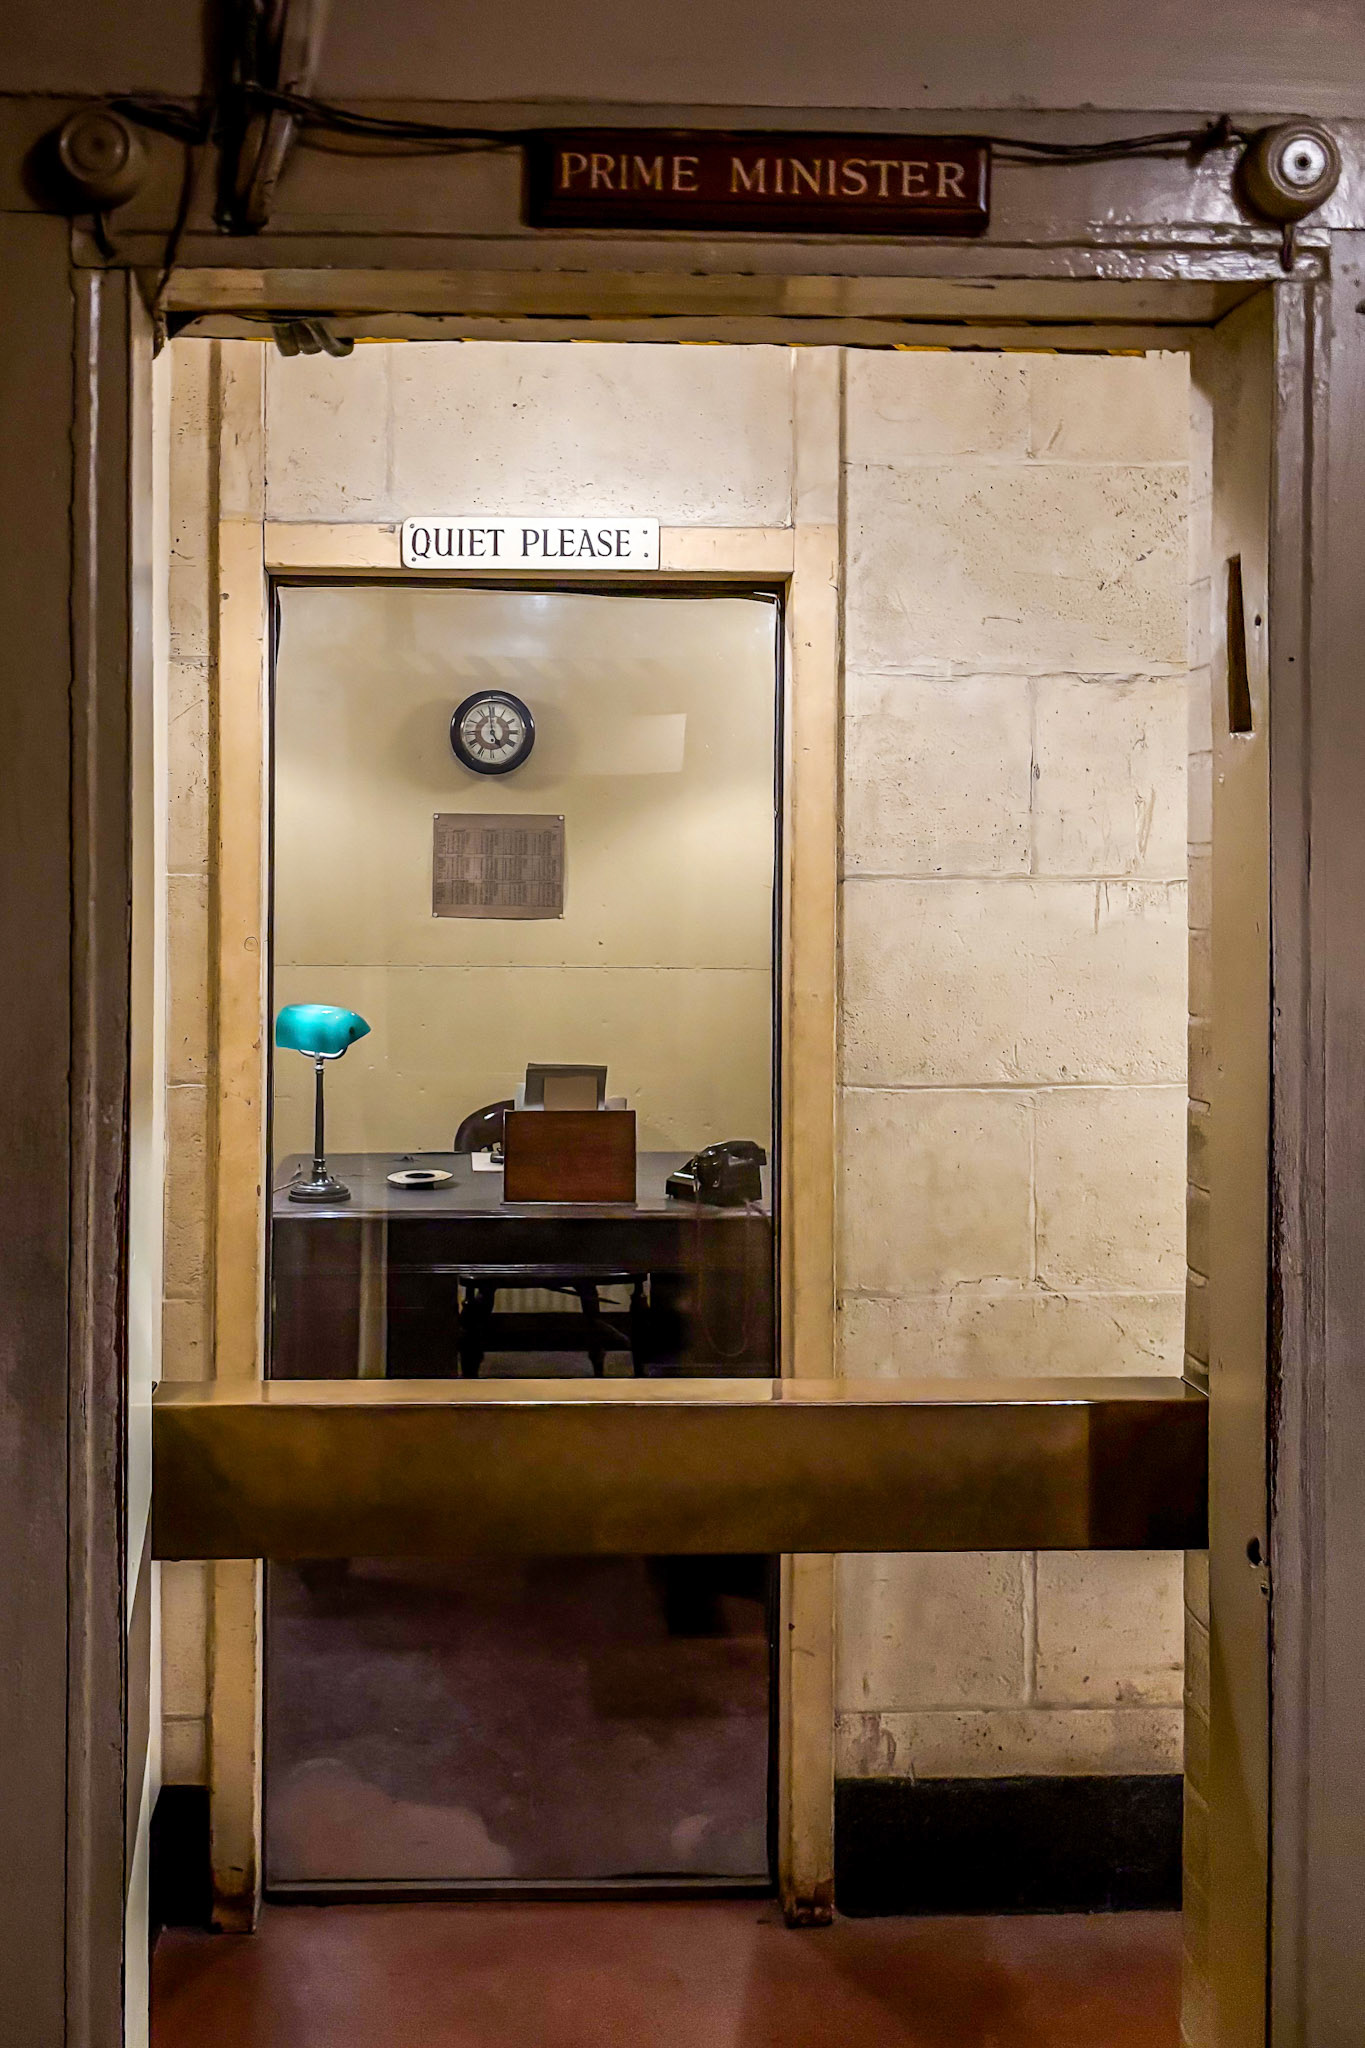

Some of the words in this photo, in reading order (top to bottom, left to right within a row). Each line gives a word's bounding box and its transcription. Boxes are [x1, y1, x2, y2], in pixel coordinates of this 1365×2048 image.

[559, 151, 700, 191] PRIME
[730, 156, 967, 198] MINISTER
[411, 527, 505, 559] QUIET
[521, 529, 632, 558] PLEASE
